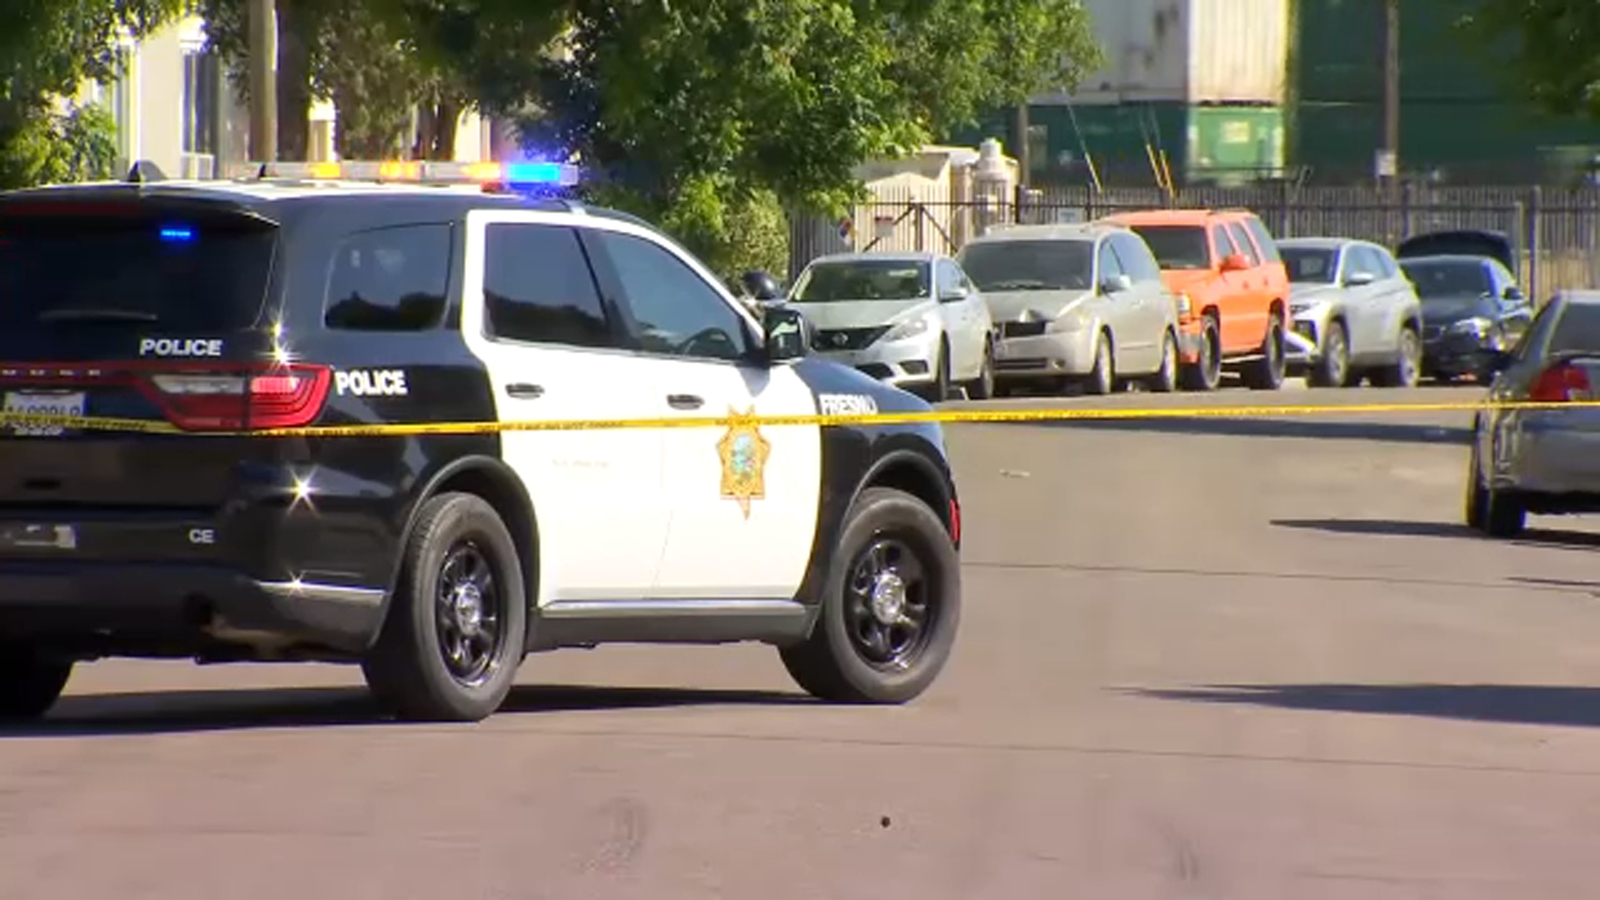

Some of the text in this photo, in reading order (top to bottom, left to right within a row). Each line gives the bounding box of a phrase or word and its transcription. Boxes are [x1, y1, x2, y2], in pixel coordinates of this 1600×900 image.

[139, 339, 222, 356] POLICE
[335, 370, 408, 395] POLICE
[189, 529, 214, 543] CE
